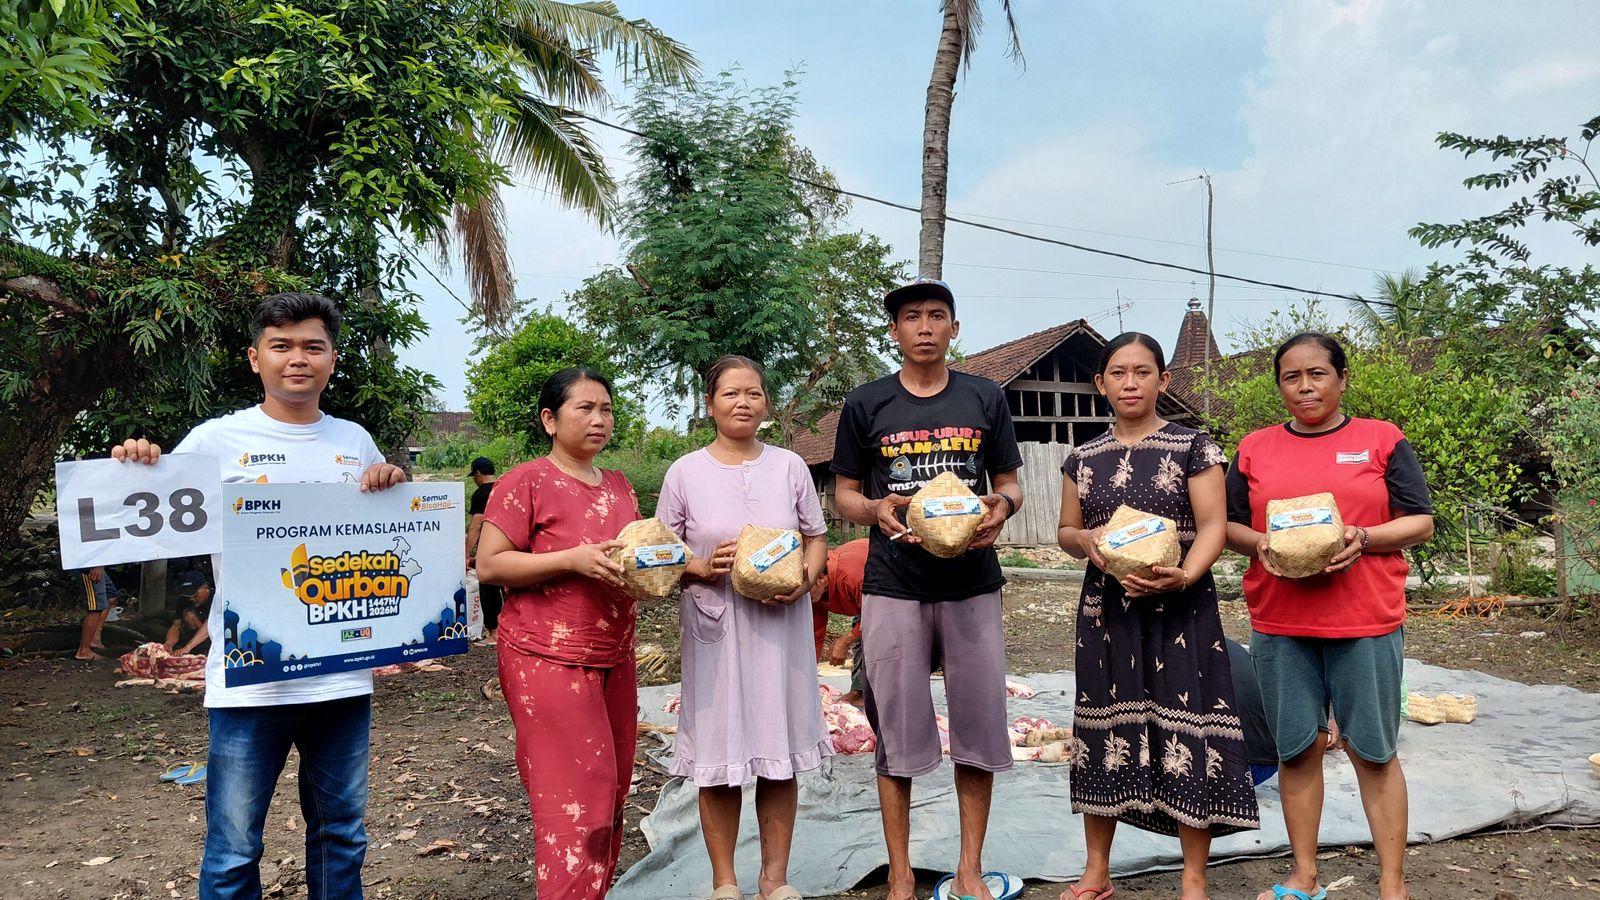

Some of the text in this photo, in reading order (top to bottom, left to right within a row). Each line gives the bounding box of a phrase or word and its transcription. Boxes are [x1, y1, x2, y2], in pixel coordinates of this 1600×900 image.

[881, 437, 982, 458] IKAN LELE
[250, 454, 286, 463] BPKH
[422, 494, 448, 502] Semua
[245, 500, 281, 511] BPKH
[421, 500, 452, 511] BisaHaji
[78, 488, 208, 543] L38
[256, 521, 440, 539] PROGRAM KEMASLAHATAN
[299, 572, 409, 607] Qurban
[309, 596, 399, 623] BPKH 1447H/
[369, 605, 398, 616] 2026M
